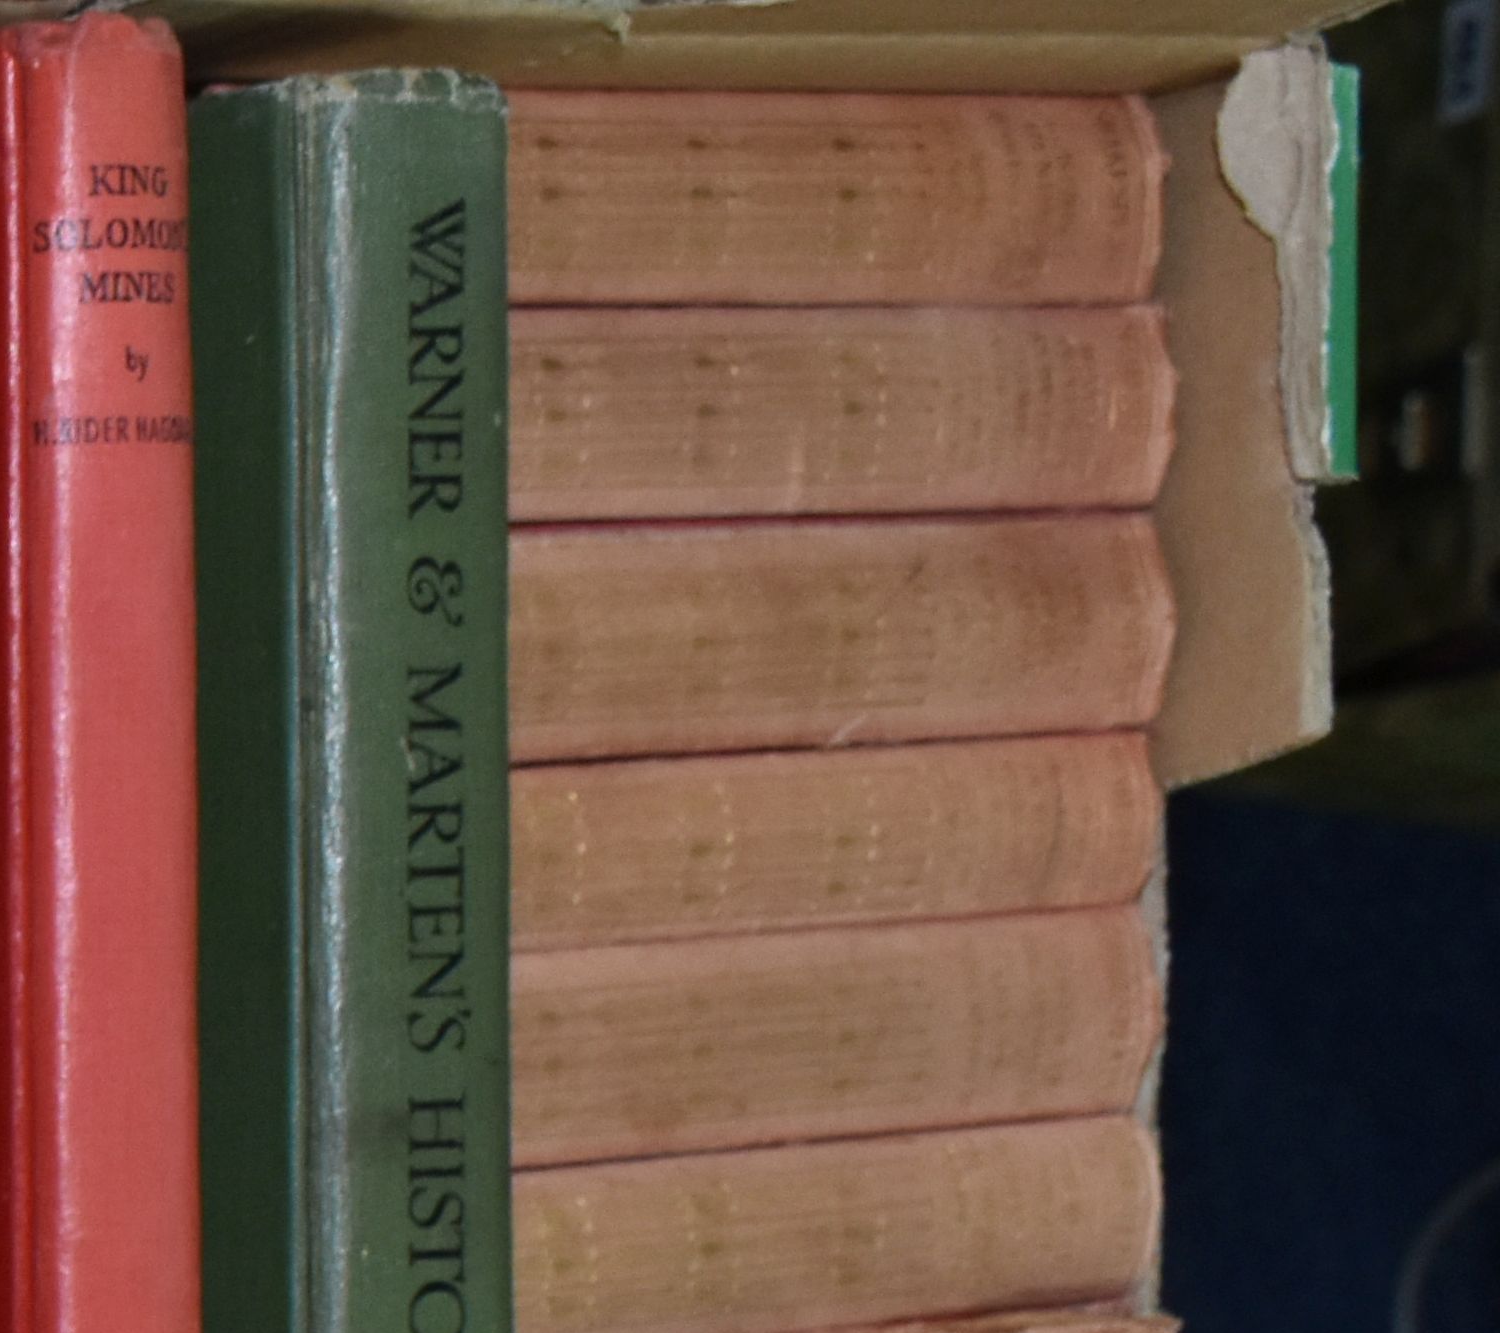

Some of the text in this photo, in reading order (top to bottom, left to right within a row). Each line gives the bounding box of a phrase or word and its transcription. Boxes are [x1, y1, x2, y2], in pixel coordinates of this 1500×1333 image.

[88, 164, 169, 197] KING
[79, 272, 174, 304] MINES
[125, 347, 148, 379] by
[407, 201, 467, 519] WARNER
[407, 553, 462, 627] &
[407, 663, 473, 1055] MARTEN'S
